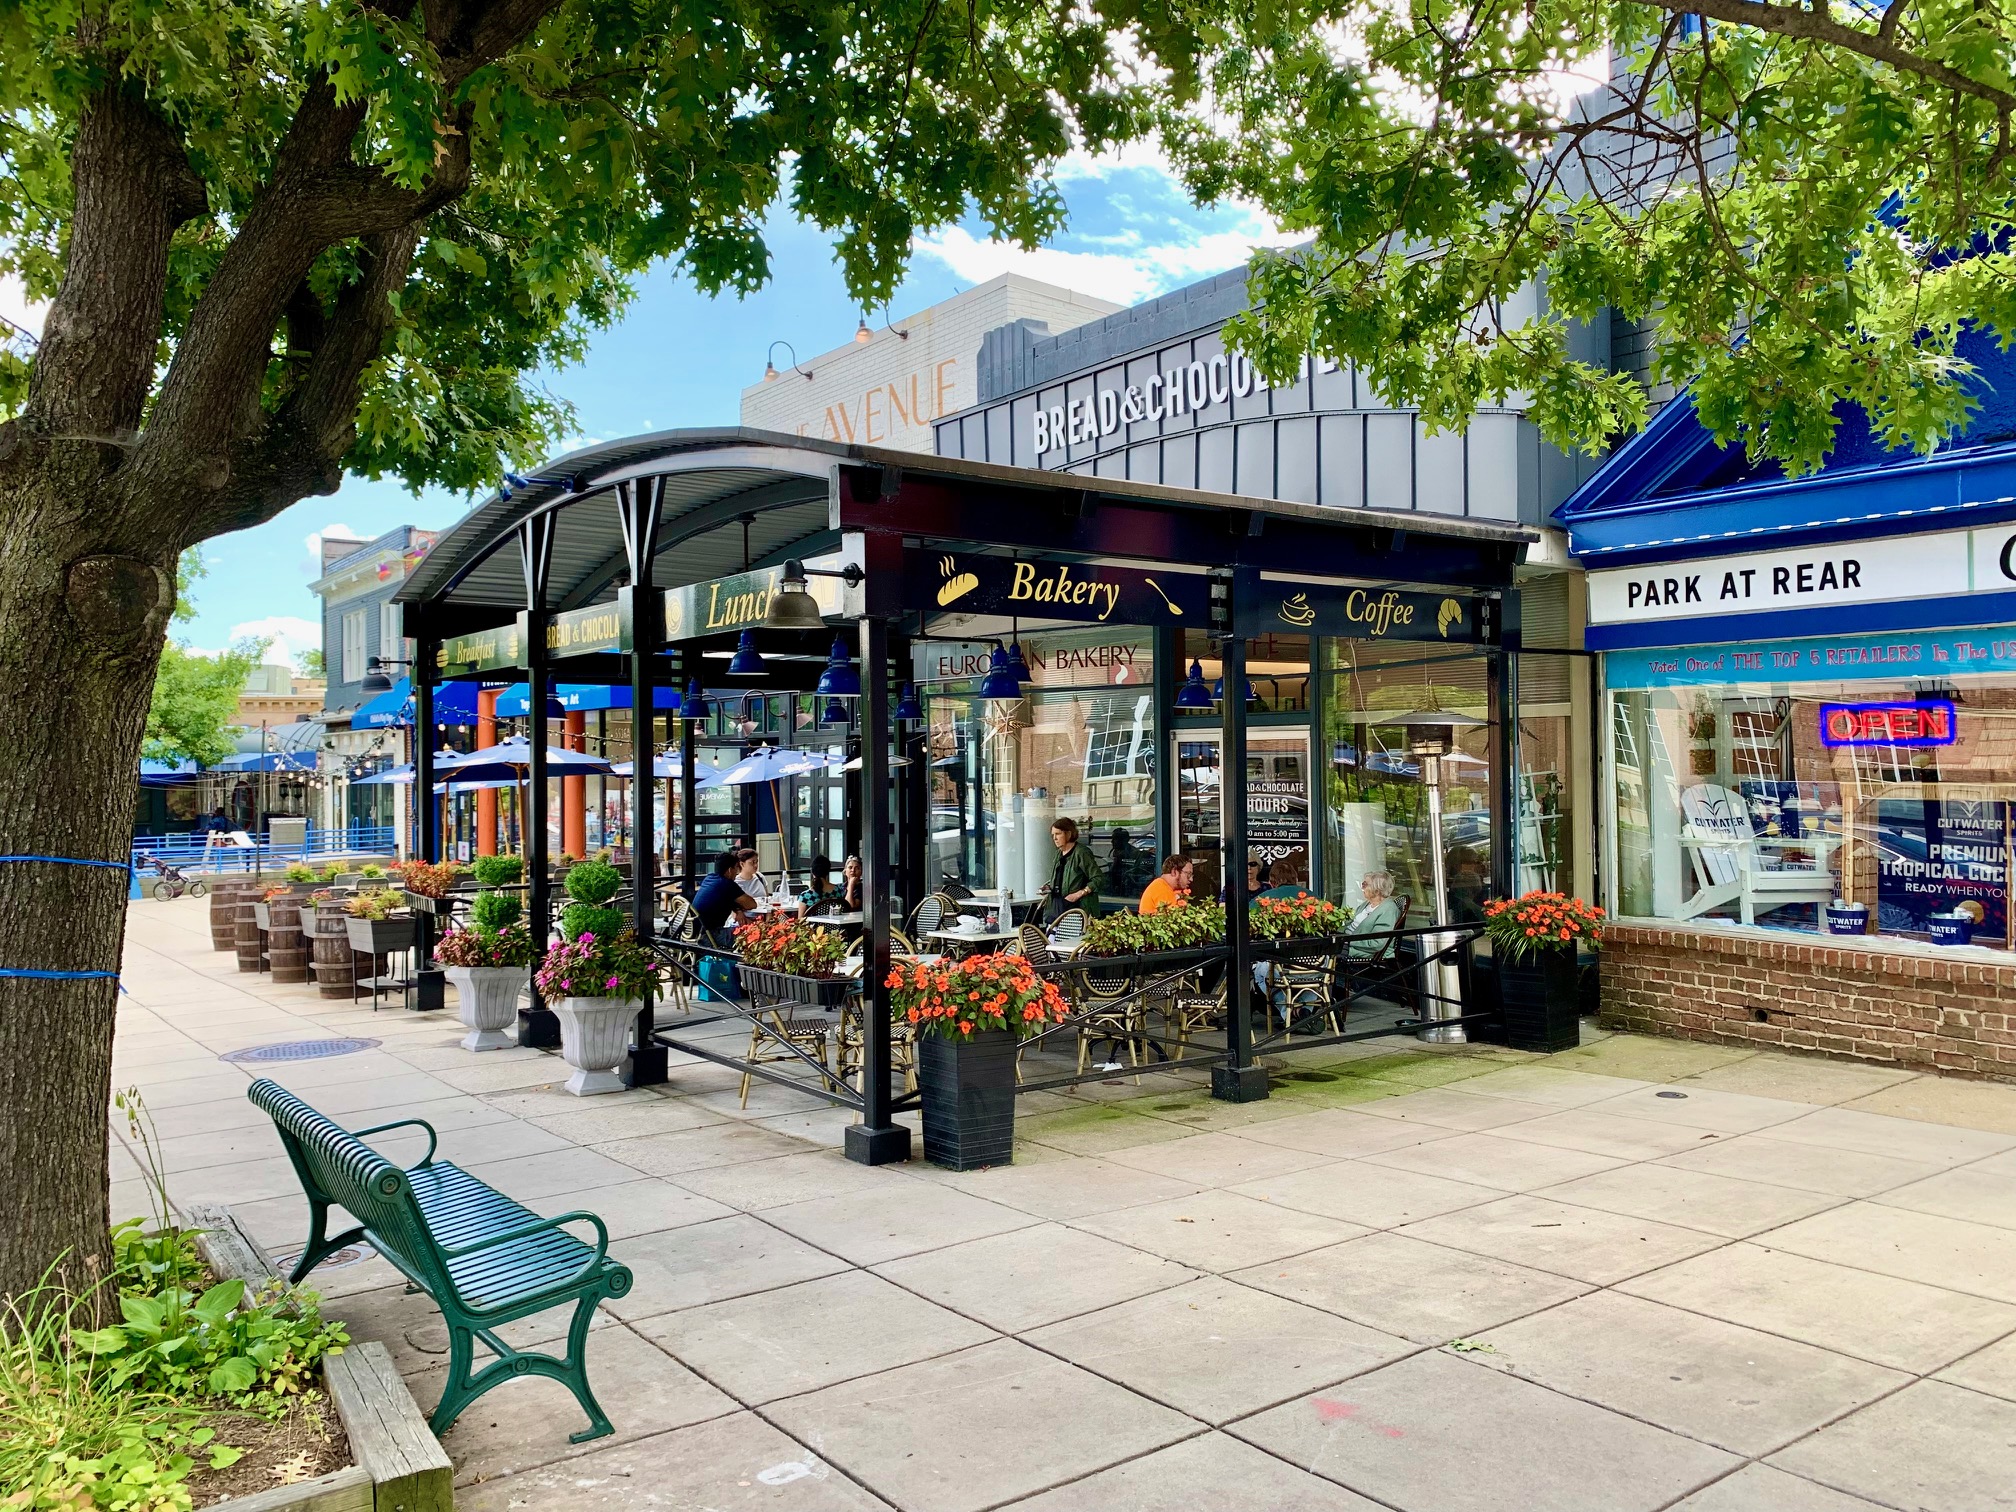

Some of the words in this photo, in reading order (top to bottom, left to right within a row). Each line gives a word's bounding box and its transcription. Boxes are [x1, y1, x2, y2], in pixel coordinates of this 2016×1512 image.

[822, 358, 959, 443] AVENUE
[1008, 562, 1120, 620] Bakery
[1628, 575, 1702, 608] PARK
[1719, 569, 1756, 600] AT
[1773, 559, 1861, 596] REAR
[1345, 589, 1414, 636] Coffee
[546, 623, 571, 649] BREAD
[572, 624, 580, 643] &
[581, 613, 620, 644] CHOCOLA
[456, 636, 496, 669] Breakfast
[939, 650, 1046, 676] EUROAN
[1056, 644, 1138, 670] BAKERY
[1648, 659, 1679, 674] Voted
[1686, 657, 1709, 672] One
[1712, 654, 1725, 671] of
[1731, 652, 1764, 671] THE
[1770, 651, 1800, 669] TOP
[1809, 650, 1820, 666] 5
[1826, 644, 1922, 666] RETAILERS
[1932, 643, 1949, 662] In
[1954, 641, 1988, 661] The
[1828, 708, 1946, 740] OPEN
[1246, 782, 1304, 792] AD&CHOCOLATE
[1247, 797, 1289, 813] HOURS
[1288, 831, 1300, 839] pm
[1694, 816, 1745, 828] CUTWATER
[1937, 818, 2003, 830] CUTWATER
[1880, 860, 1964, 881] TROPICAL
[1905, 882, 1944, 894] READY
[1945, 884, 1983, 898] WHEN
